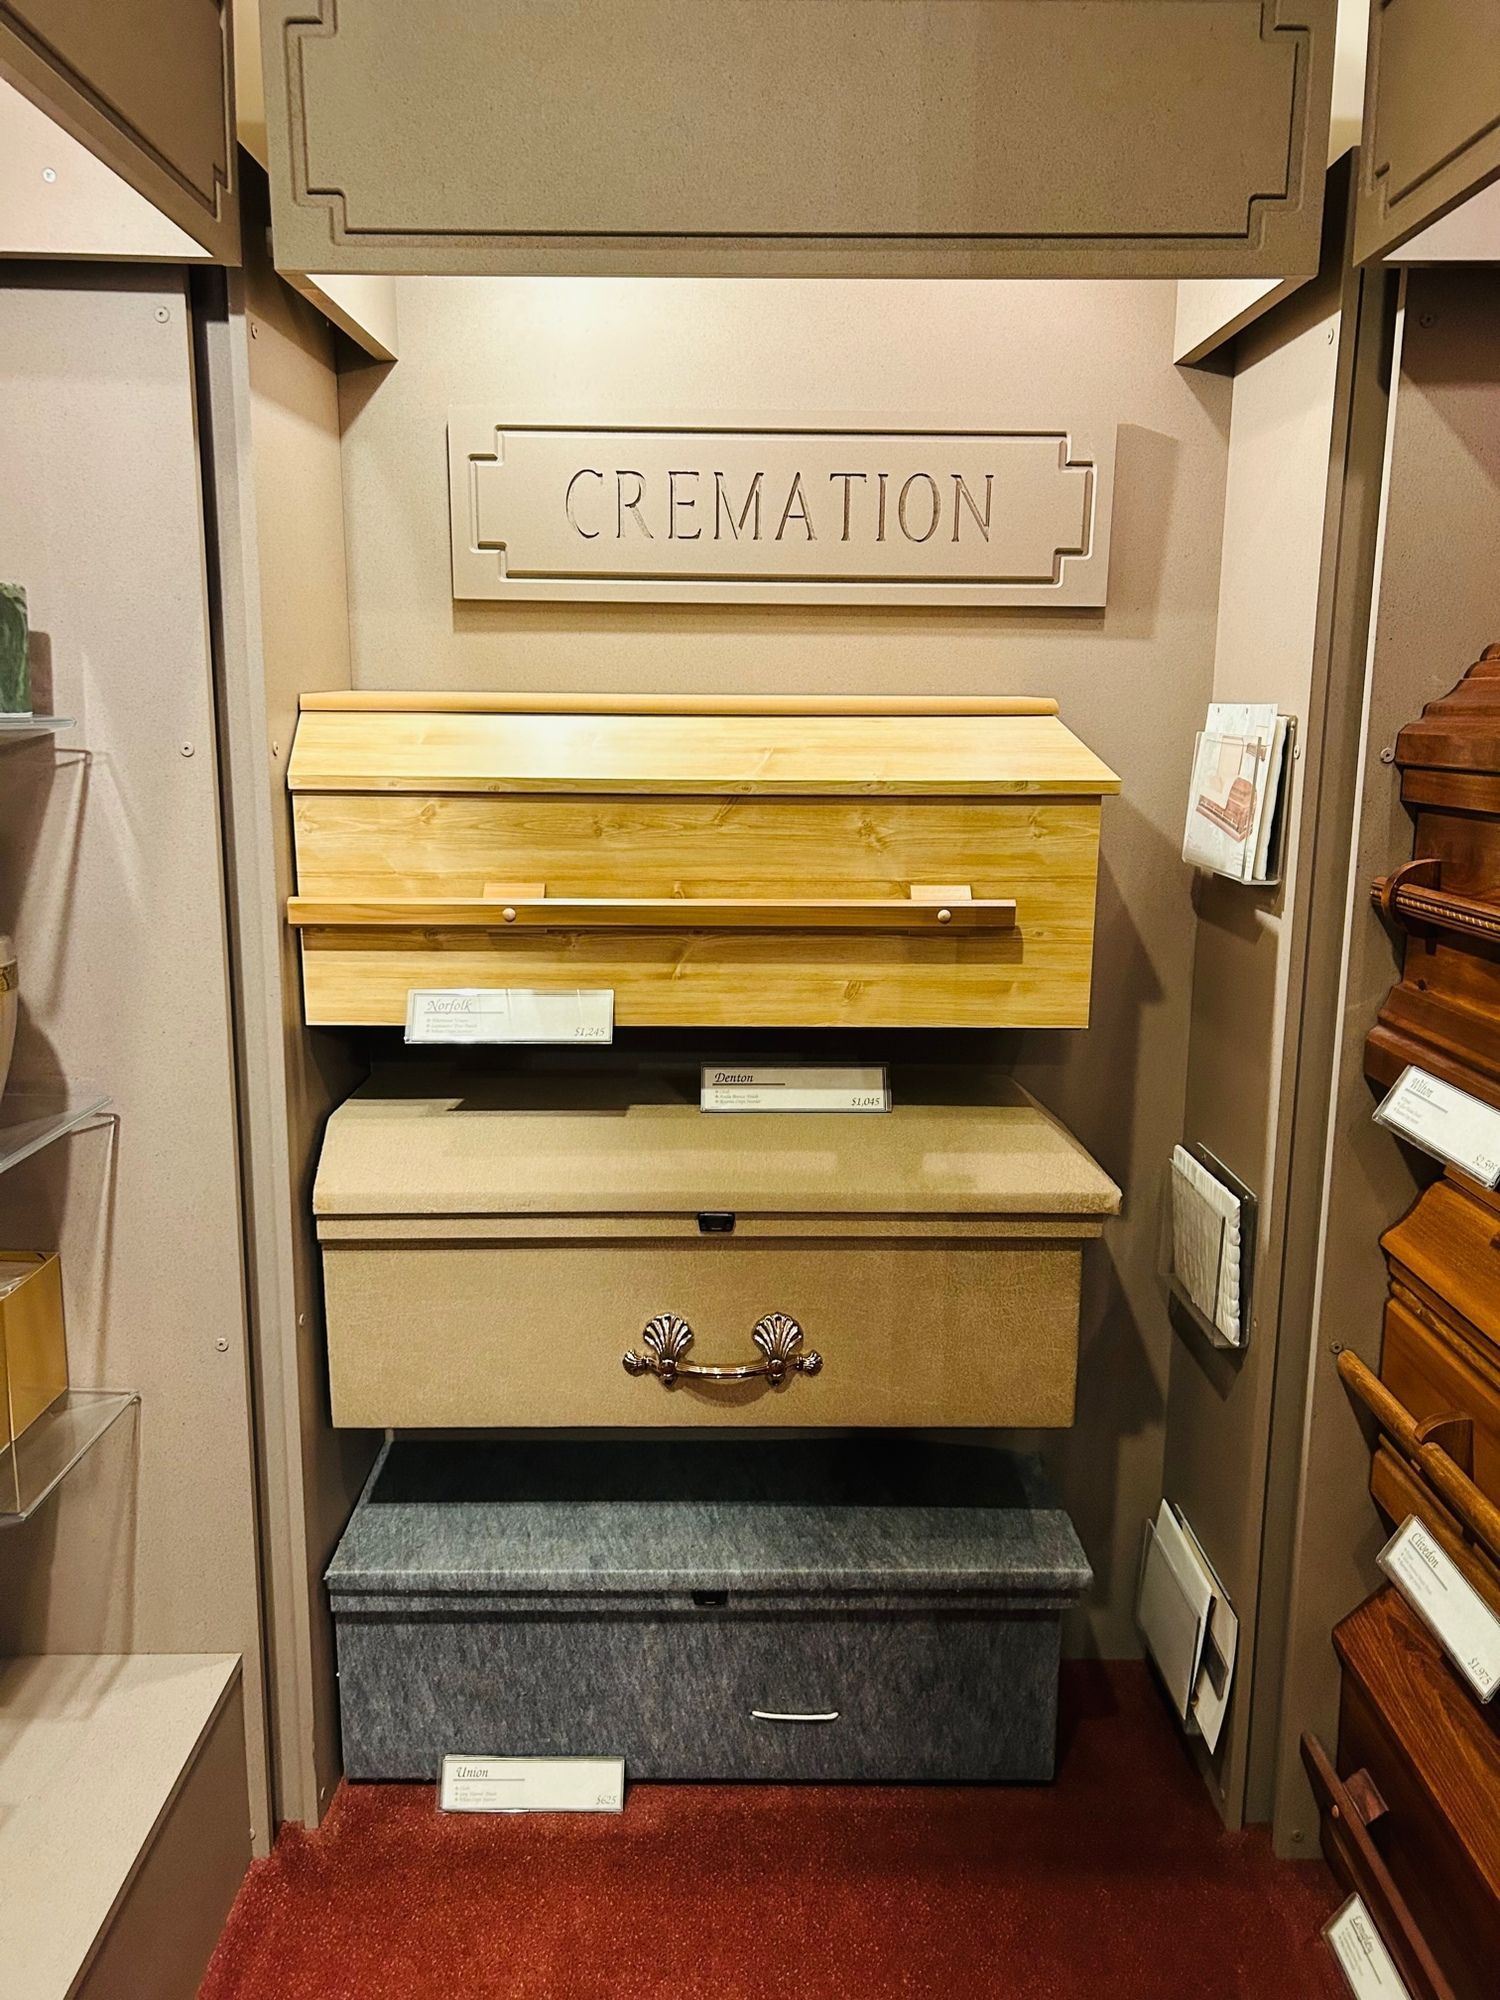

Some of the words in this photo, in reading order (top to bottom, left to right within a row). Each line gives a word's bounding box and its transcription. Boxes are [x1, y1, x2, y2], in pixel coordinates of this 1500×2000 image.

[565, 469, 995, 542] CREMATION
[426, 998, 473, 1014] Norfolk
[574, 1027, 605, 1037] $1,245
[714, 1073, 754, 1082] Denton
[851, 1097, 881, 1107] $1,045
[1411, 1532, 1440, 1568] Clivedon
[1467, 1657, 1493, 1686] $1,975
[456, 1766, 489, 1778] Union
[595, 1795, 617, 1805] $625
